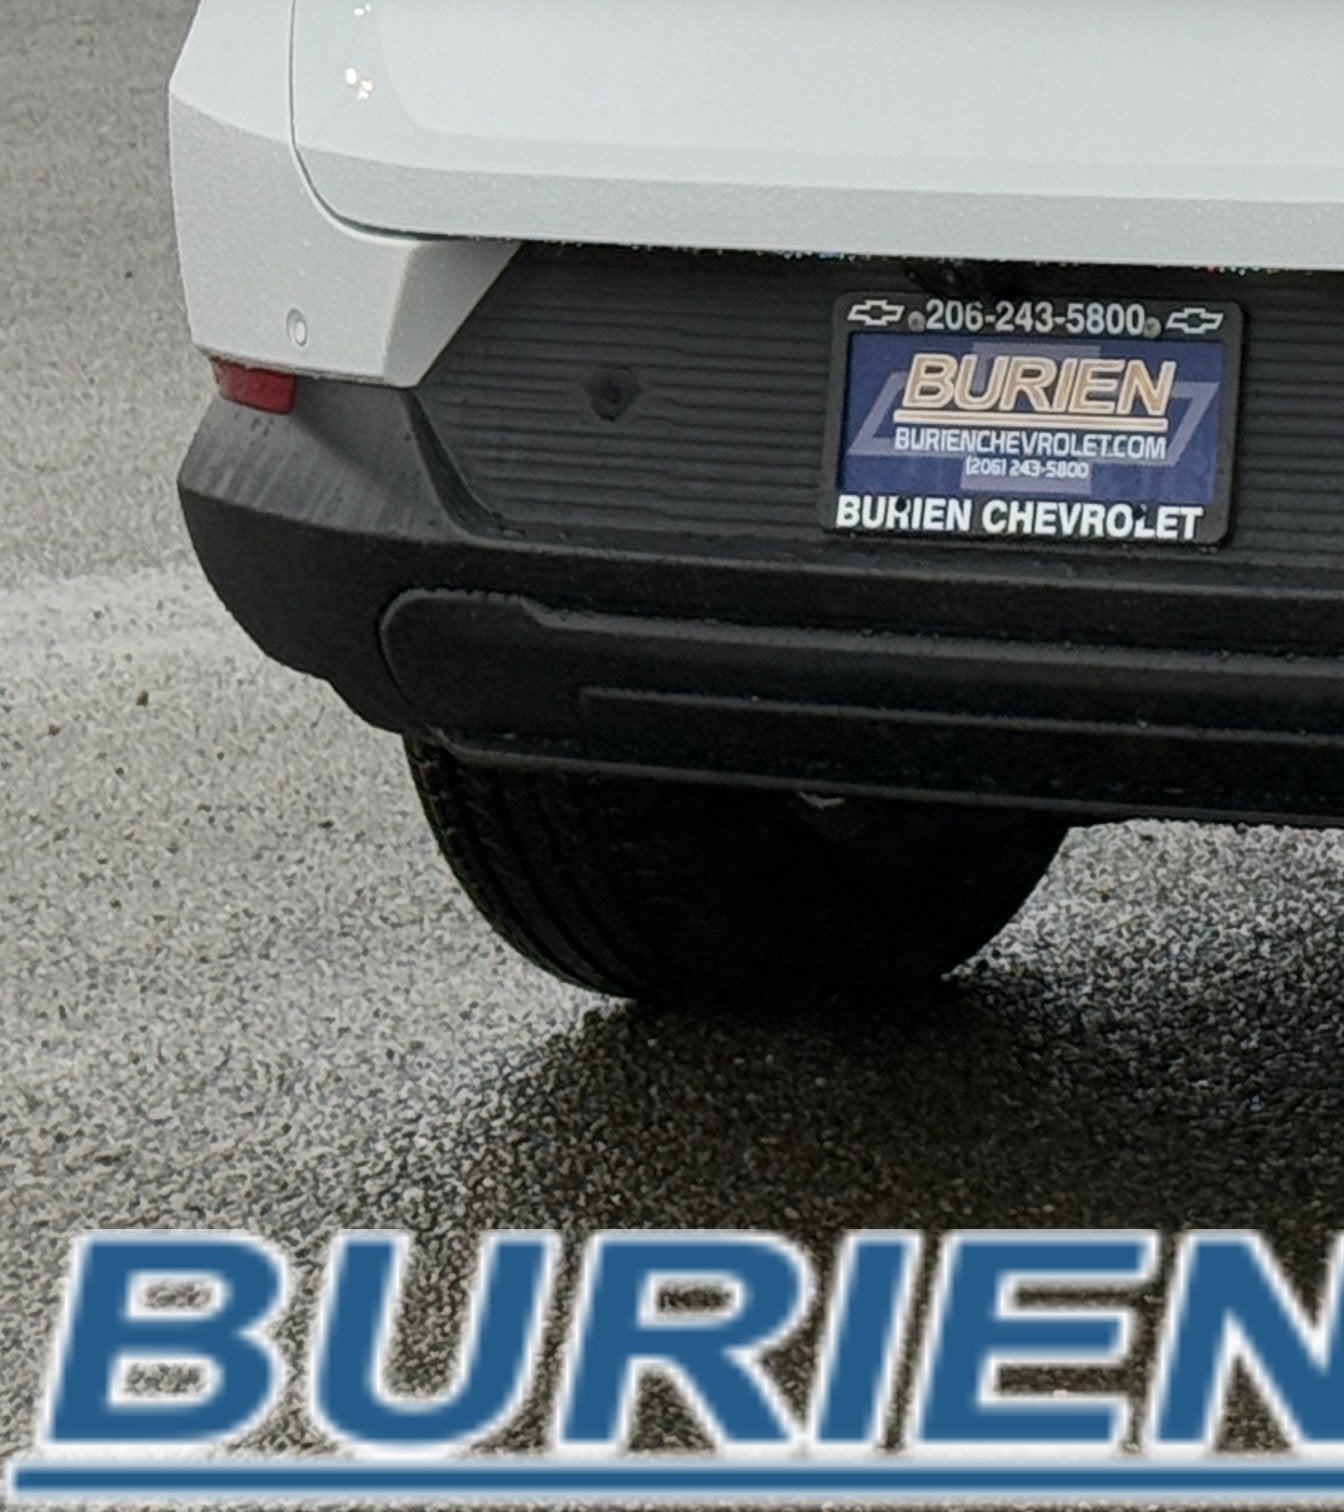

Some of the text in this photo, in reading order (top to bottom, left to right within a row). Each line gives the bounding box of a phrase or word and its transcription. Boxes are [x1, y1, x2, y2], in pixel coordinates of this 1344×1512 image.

[925, 298, 1146, 336] 206-243-5800
[901, 352, 1177, 417] BURIEN
[894, 426, 1167, 460] BURIENCHEVROLET.COM
[1009, 457, 1090, 479] 243-5800
[836, 494, 1204, 540] BURIEN CHEVROLET
